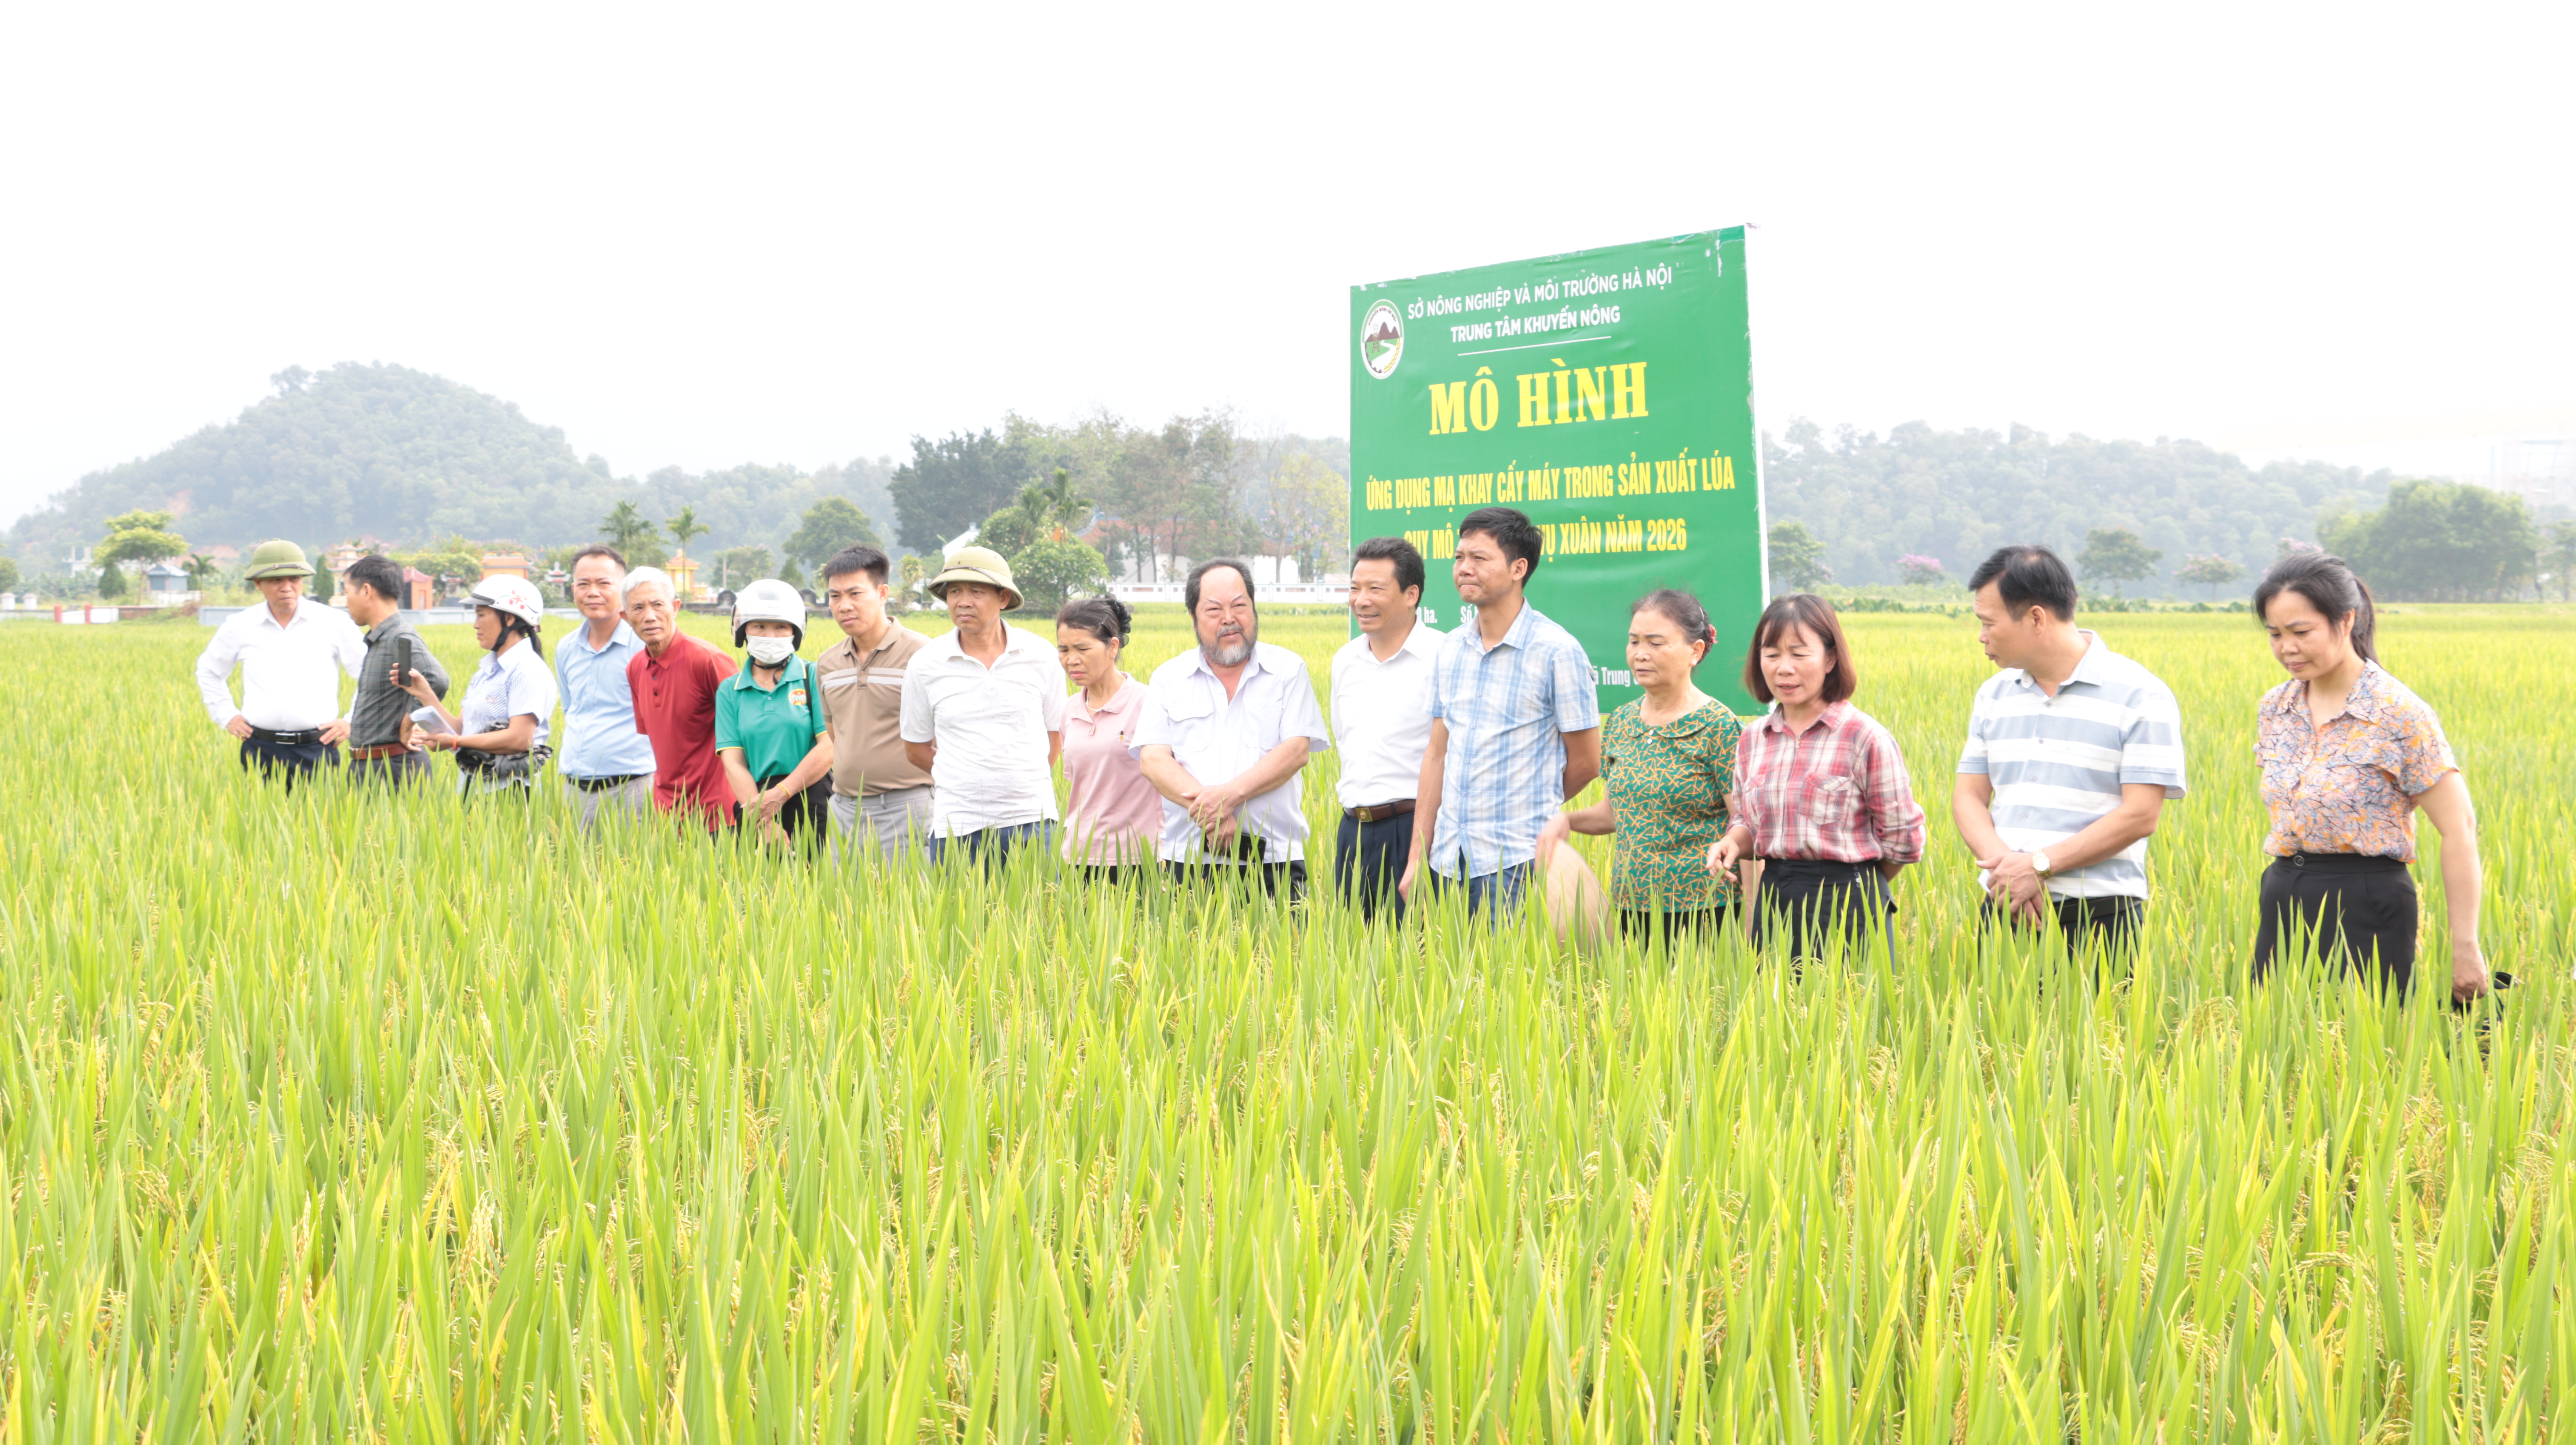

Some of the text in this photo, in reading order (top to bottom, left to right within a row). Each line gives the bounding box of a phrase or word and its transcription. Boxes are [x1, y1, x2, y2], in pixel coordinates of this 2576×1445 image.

[1408, 262, 1671, 319] SỞ NÔNG NGHIỆP VÀ MÔI TRƯỜNG HÀ NỘI
[1450, 304, 1620, 342] TRUNG TÂM KHUYẾN NÔNG
[1429, 358, 1648, 435] MÔ HÌNH
[1366, 447, 1735, 514] ỨNG DỤNG MẠ KHAY CẤY MÁY TRONG SẢN XUẤT LÚA
[1433, 523, 1453, 559] MÔ
[1560, 516, 1601, 554] XUÂN
[1606, 514, 1642, 553] NĂM
[1647, 518, 1687, 551] 2026
[1424, 607, 1437, 623] ha.
[1601, 667, 1630, 687] Trung
